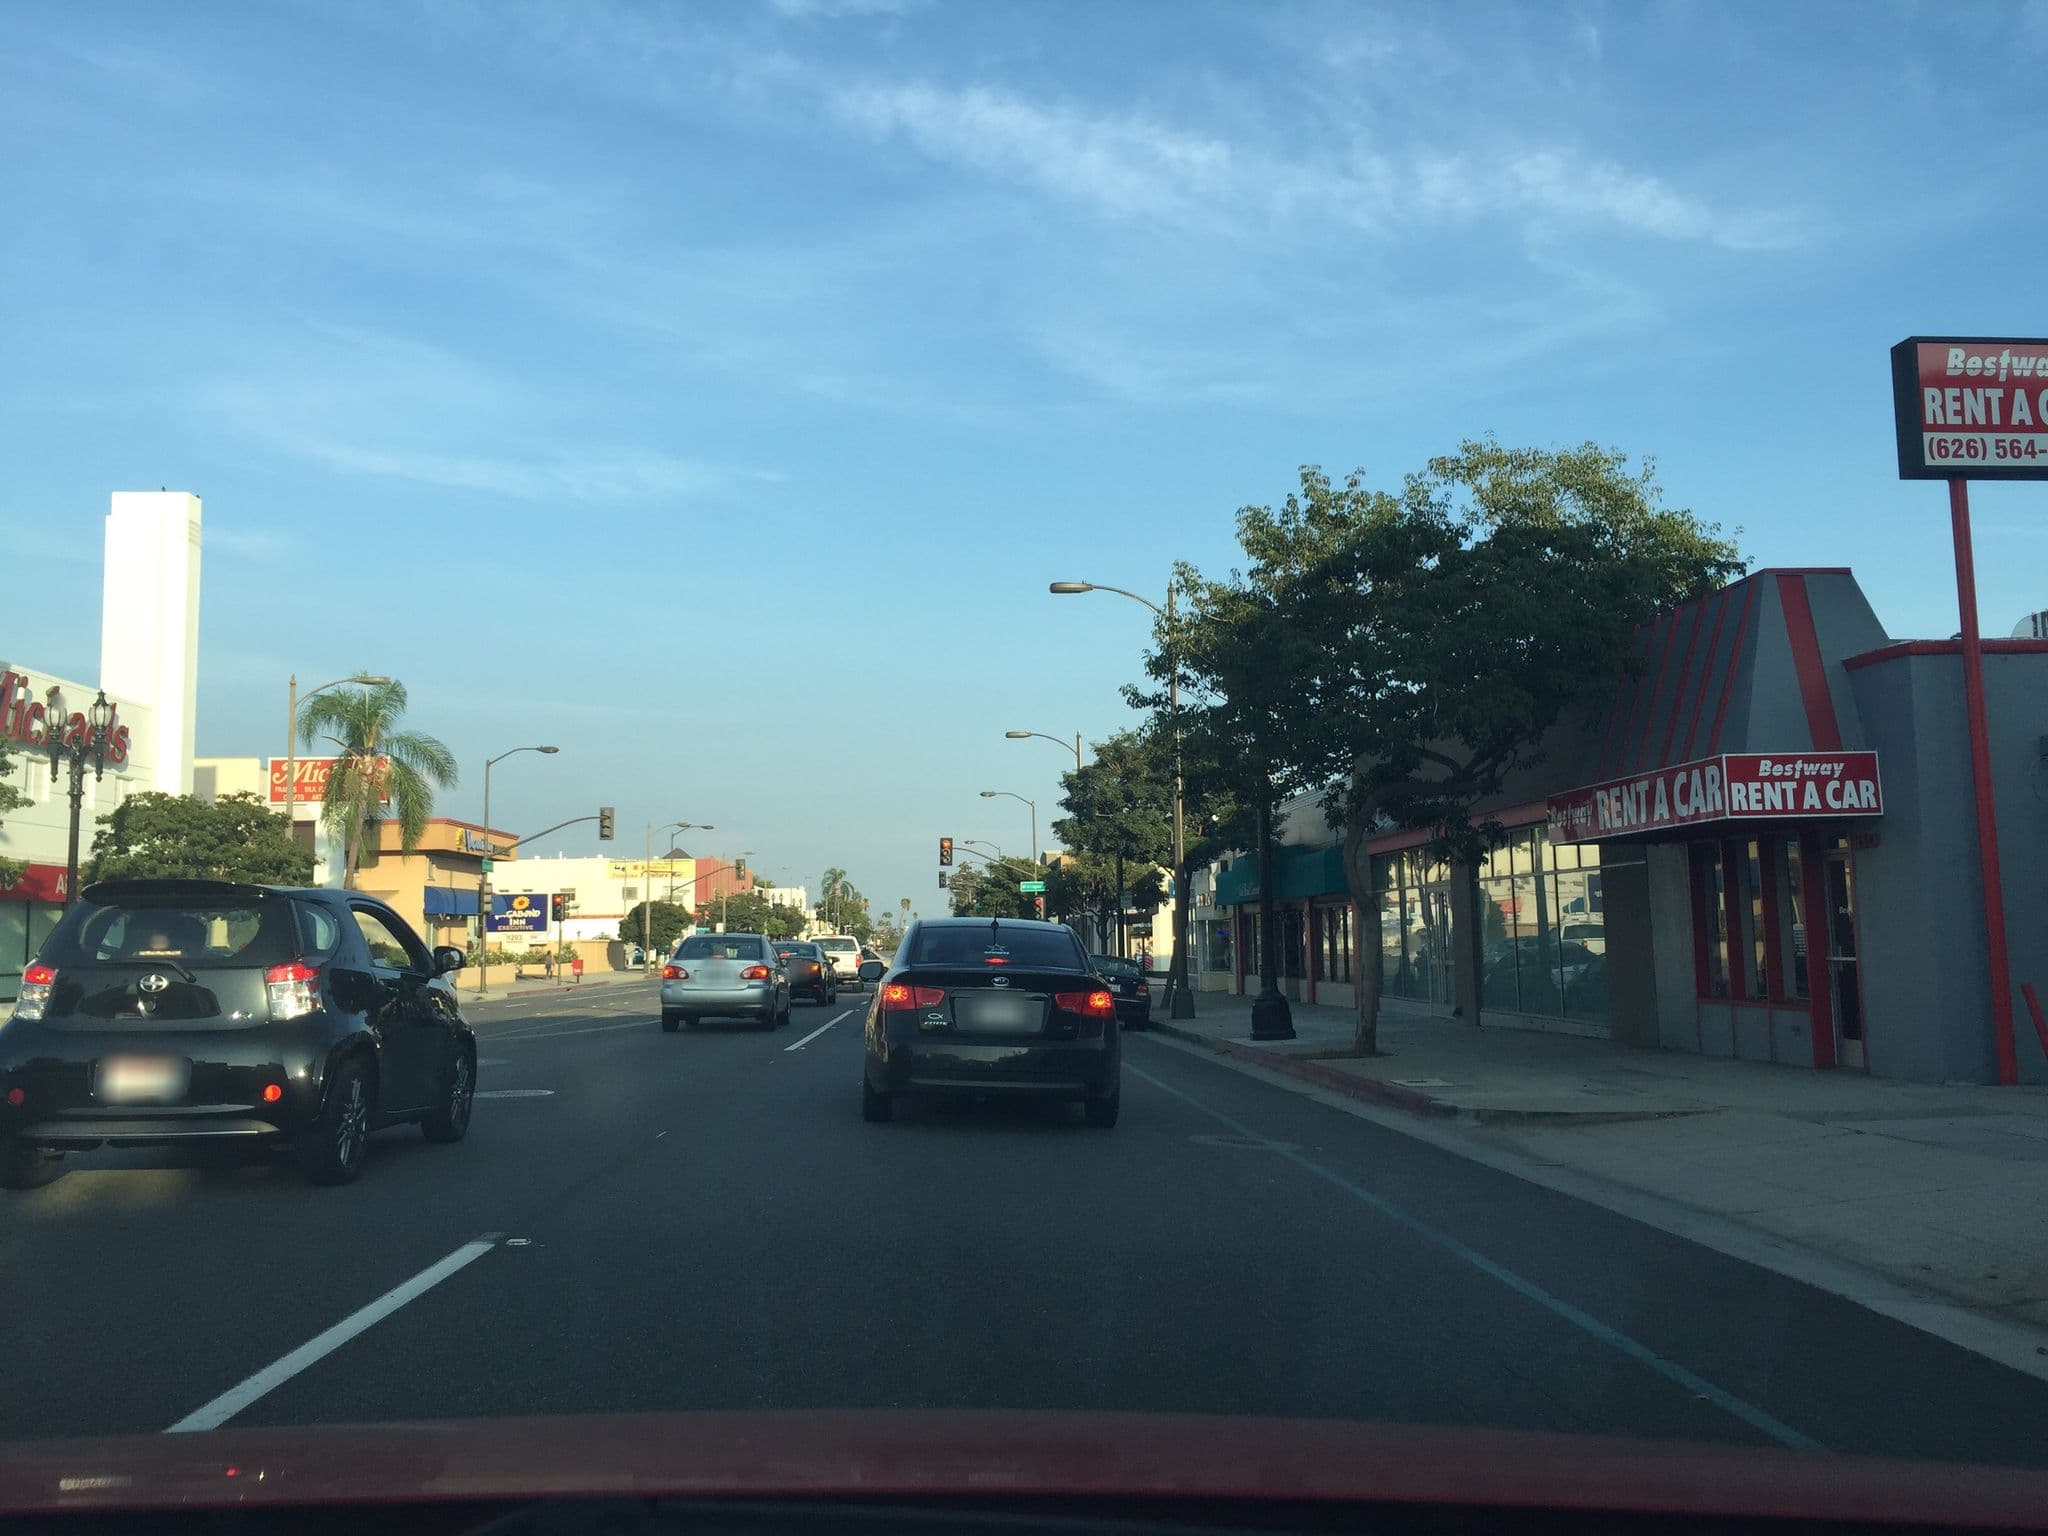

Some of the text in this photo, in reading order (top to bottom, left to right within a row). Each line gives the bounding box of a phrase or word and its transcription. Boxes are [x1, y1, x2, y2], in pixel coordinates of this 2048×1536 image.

[1923, 387, 2004, 425] RENT
[2010, 388, 2034, 425] A
[1928, 437, 1987, 461] (626)
[1758, 759, 1844, 779] Bestway
[1596, 780, 1650, 830] RENT
[1653, 777, 1671, 821] A
[1673, 764, 1723, 816] CAR
[1730, 779, 1878, 811] RENT A CAR
